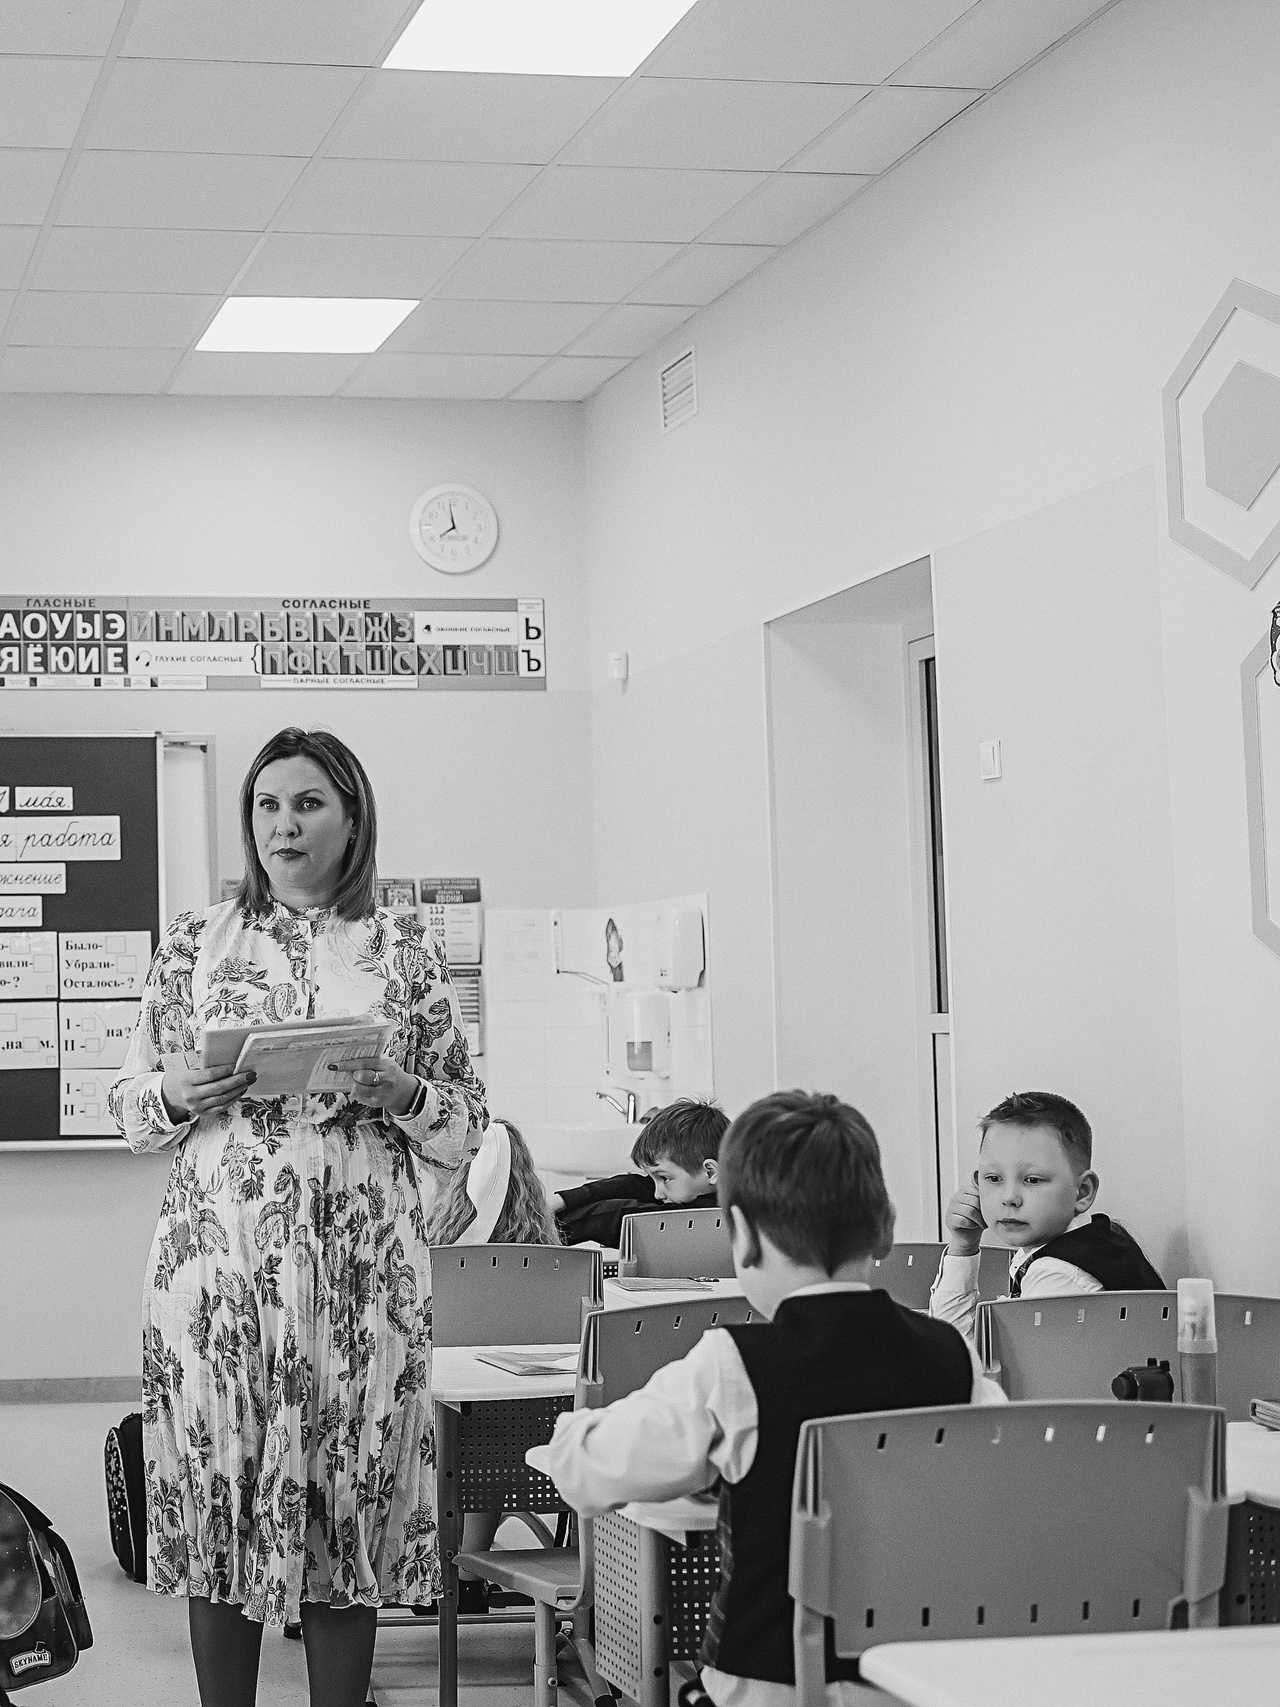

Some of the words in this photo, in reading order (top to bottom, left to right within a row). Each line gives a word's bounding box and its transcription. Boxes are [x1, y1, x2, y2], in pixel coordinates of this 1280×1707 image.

[26, 599, 96, 608] ГЛАСНЫЕ
[282, 600, 371, 609] СОГЛАСНЫЕ
[20, 820, 116, 858] работа
[429, 906, 445, 915] 112
[14, 1653, 48, 1669] SKYNAME
